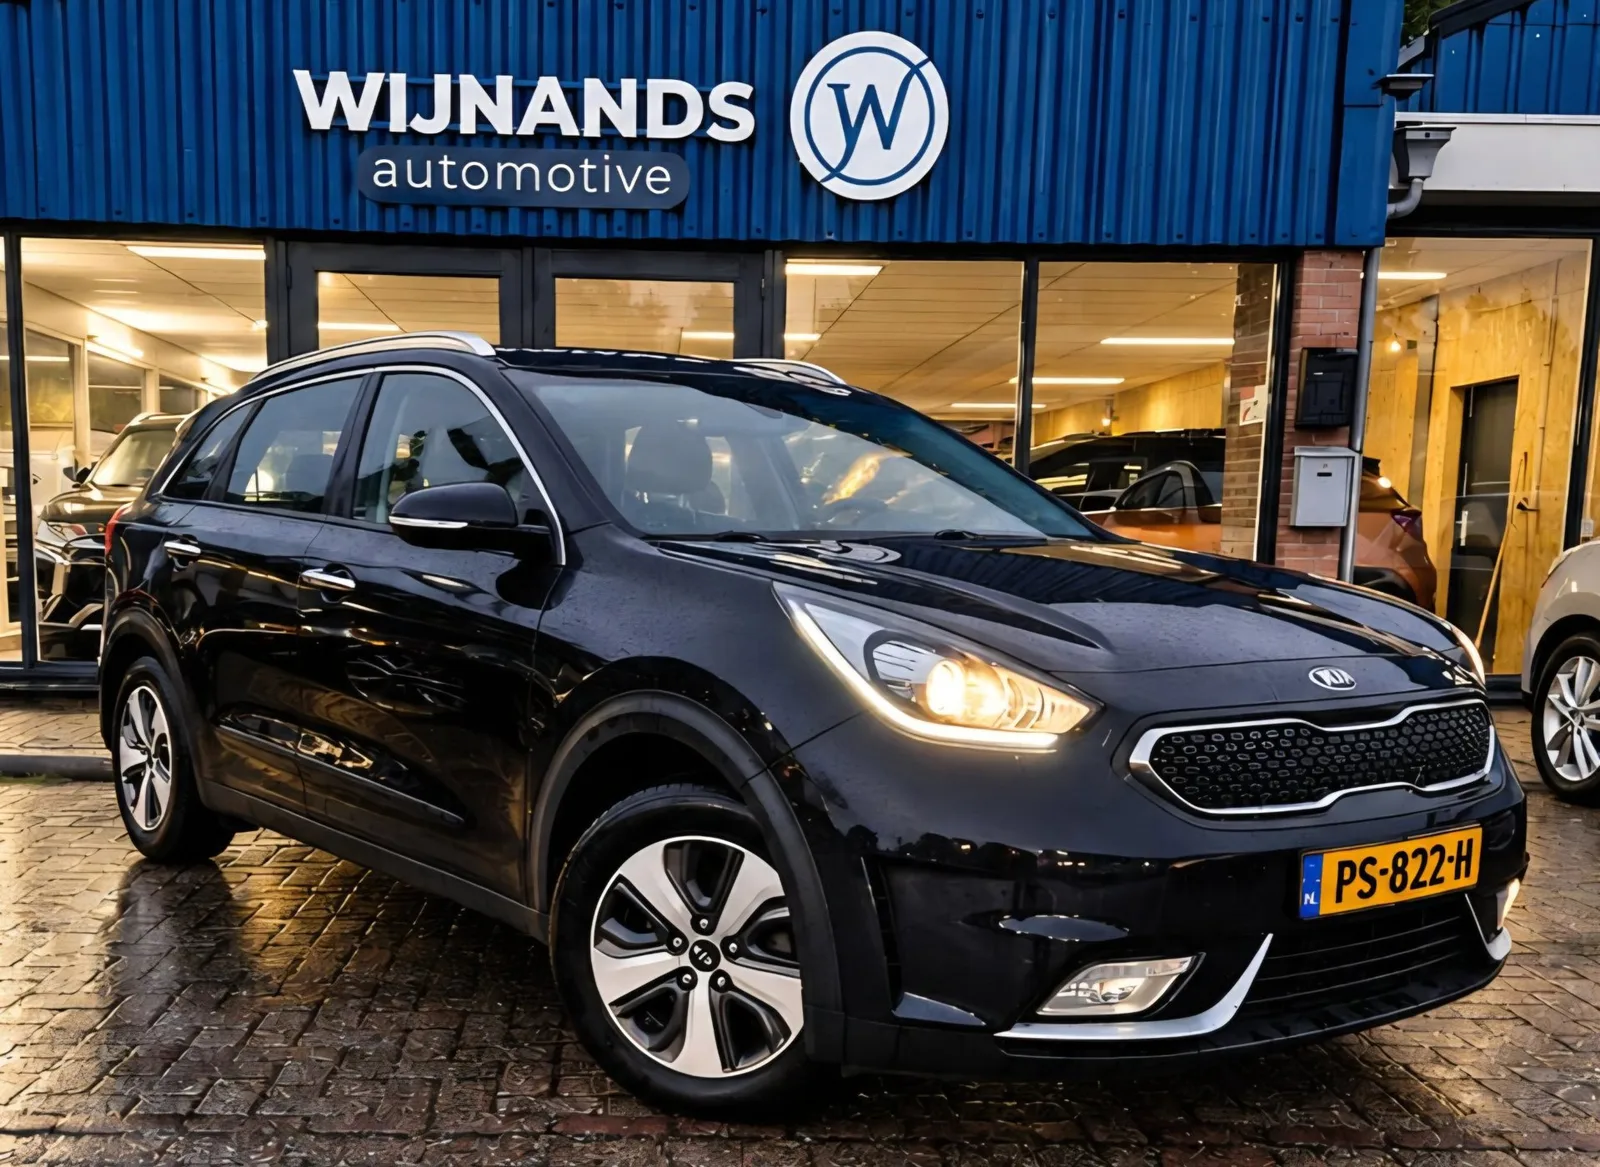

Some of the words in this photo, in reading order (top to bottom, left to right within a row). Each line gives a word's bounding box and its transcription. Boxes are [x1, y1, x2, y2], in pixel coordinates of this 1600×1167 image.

[293, 68, 756, 142] WIJNANDS
[372, 153, 672, 195] automotive
[1303, 891, 1320, 905] NL
[1335, 838, 1474, 904] PS-822-H
